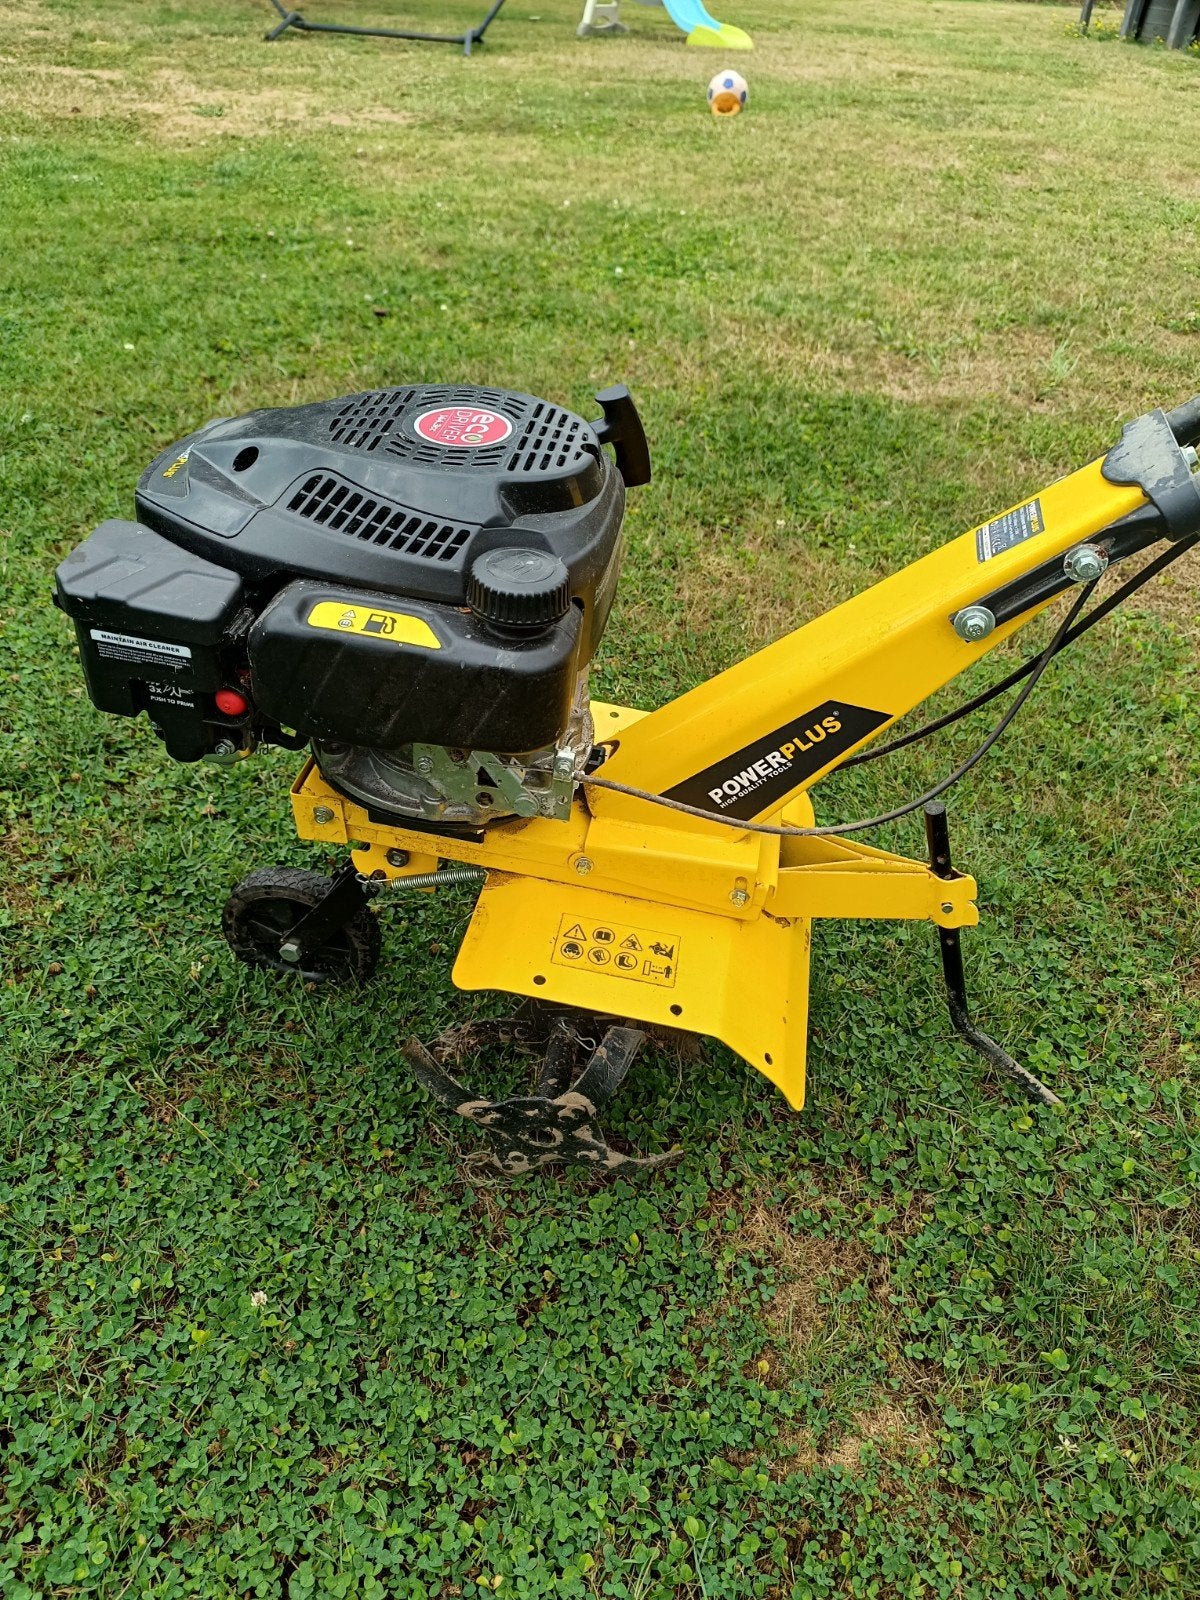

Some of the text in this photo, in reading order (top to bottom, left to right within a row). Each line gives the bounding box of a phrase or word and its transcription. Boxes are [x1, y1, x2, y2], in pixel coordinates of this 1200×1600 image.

[441, 410, 472, 441] DRIVER
[460, 414, 495, 443] eco
[101, 634, 134, 644] MAINTAIN
[148, 642, 180, 653] CLEANER
[708, 715, 842, 804] POWERPLUS
[719, 761, 793, 809] HIGH QUALITY TOOLS
